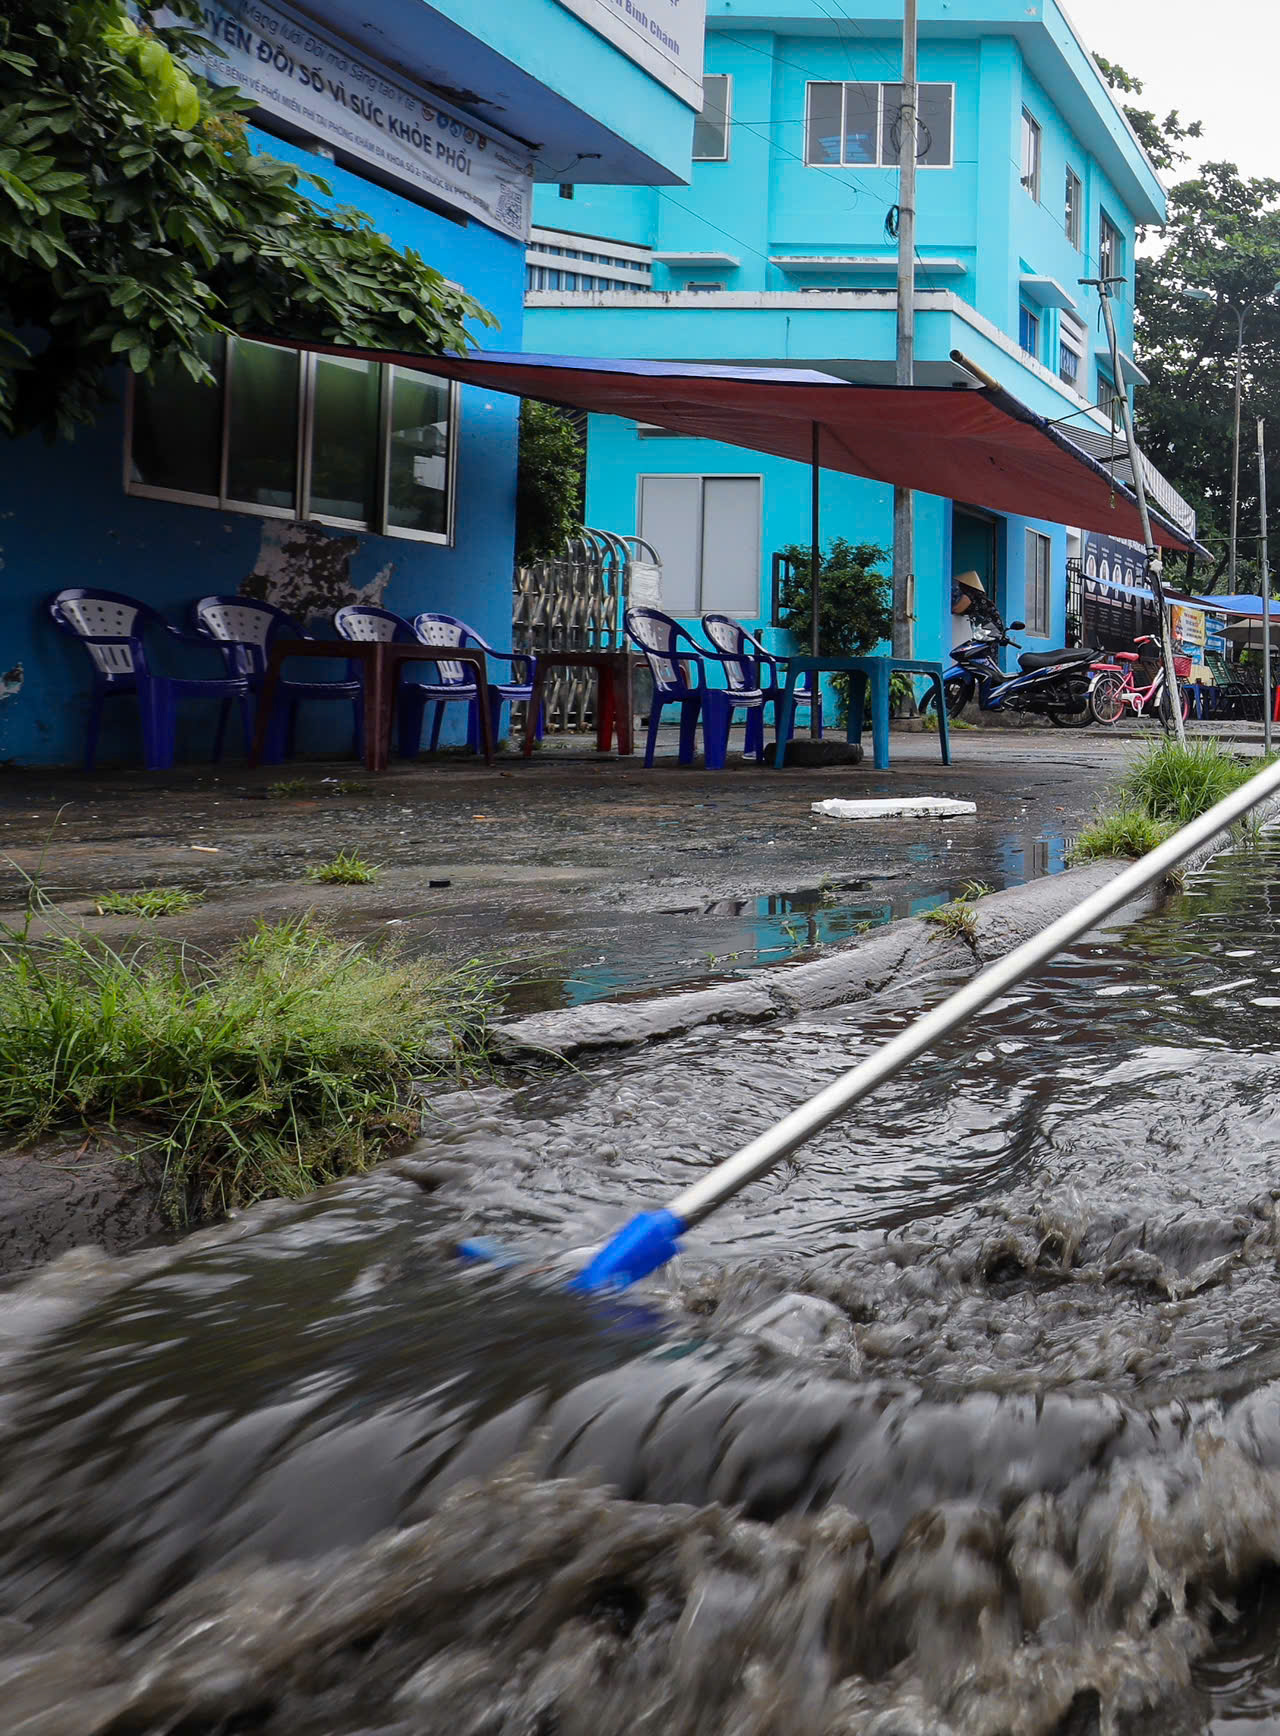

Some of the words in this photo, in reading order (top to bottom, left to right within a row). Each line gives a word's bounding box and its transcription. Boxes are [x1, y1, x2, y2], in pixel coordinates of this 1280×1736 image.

[256, 40, 295, 78] ĐỔI
[299, 63, 324, 94] SỐ
[327, 79, 346, 107] VÌ
[350, 93, 384, 128] SỨC
[388, 113, 432, 155] KHỎE
[435, 141, 472, 177] PHỔI
